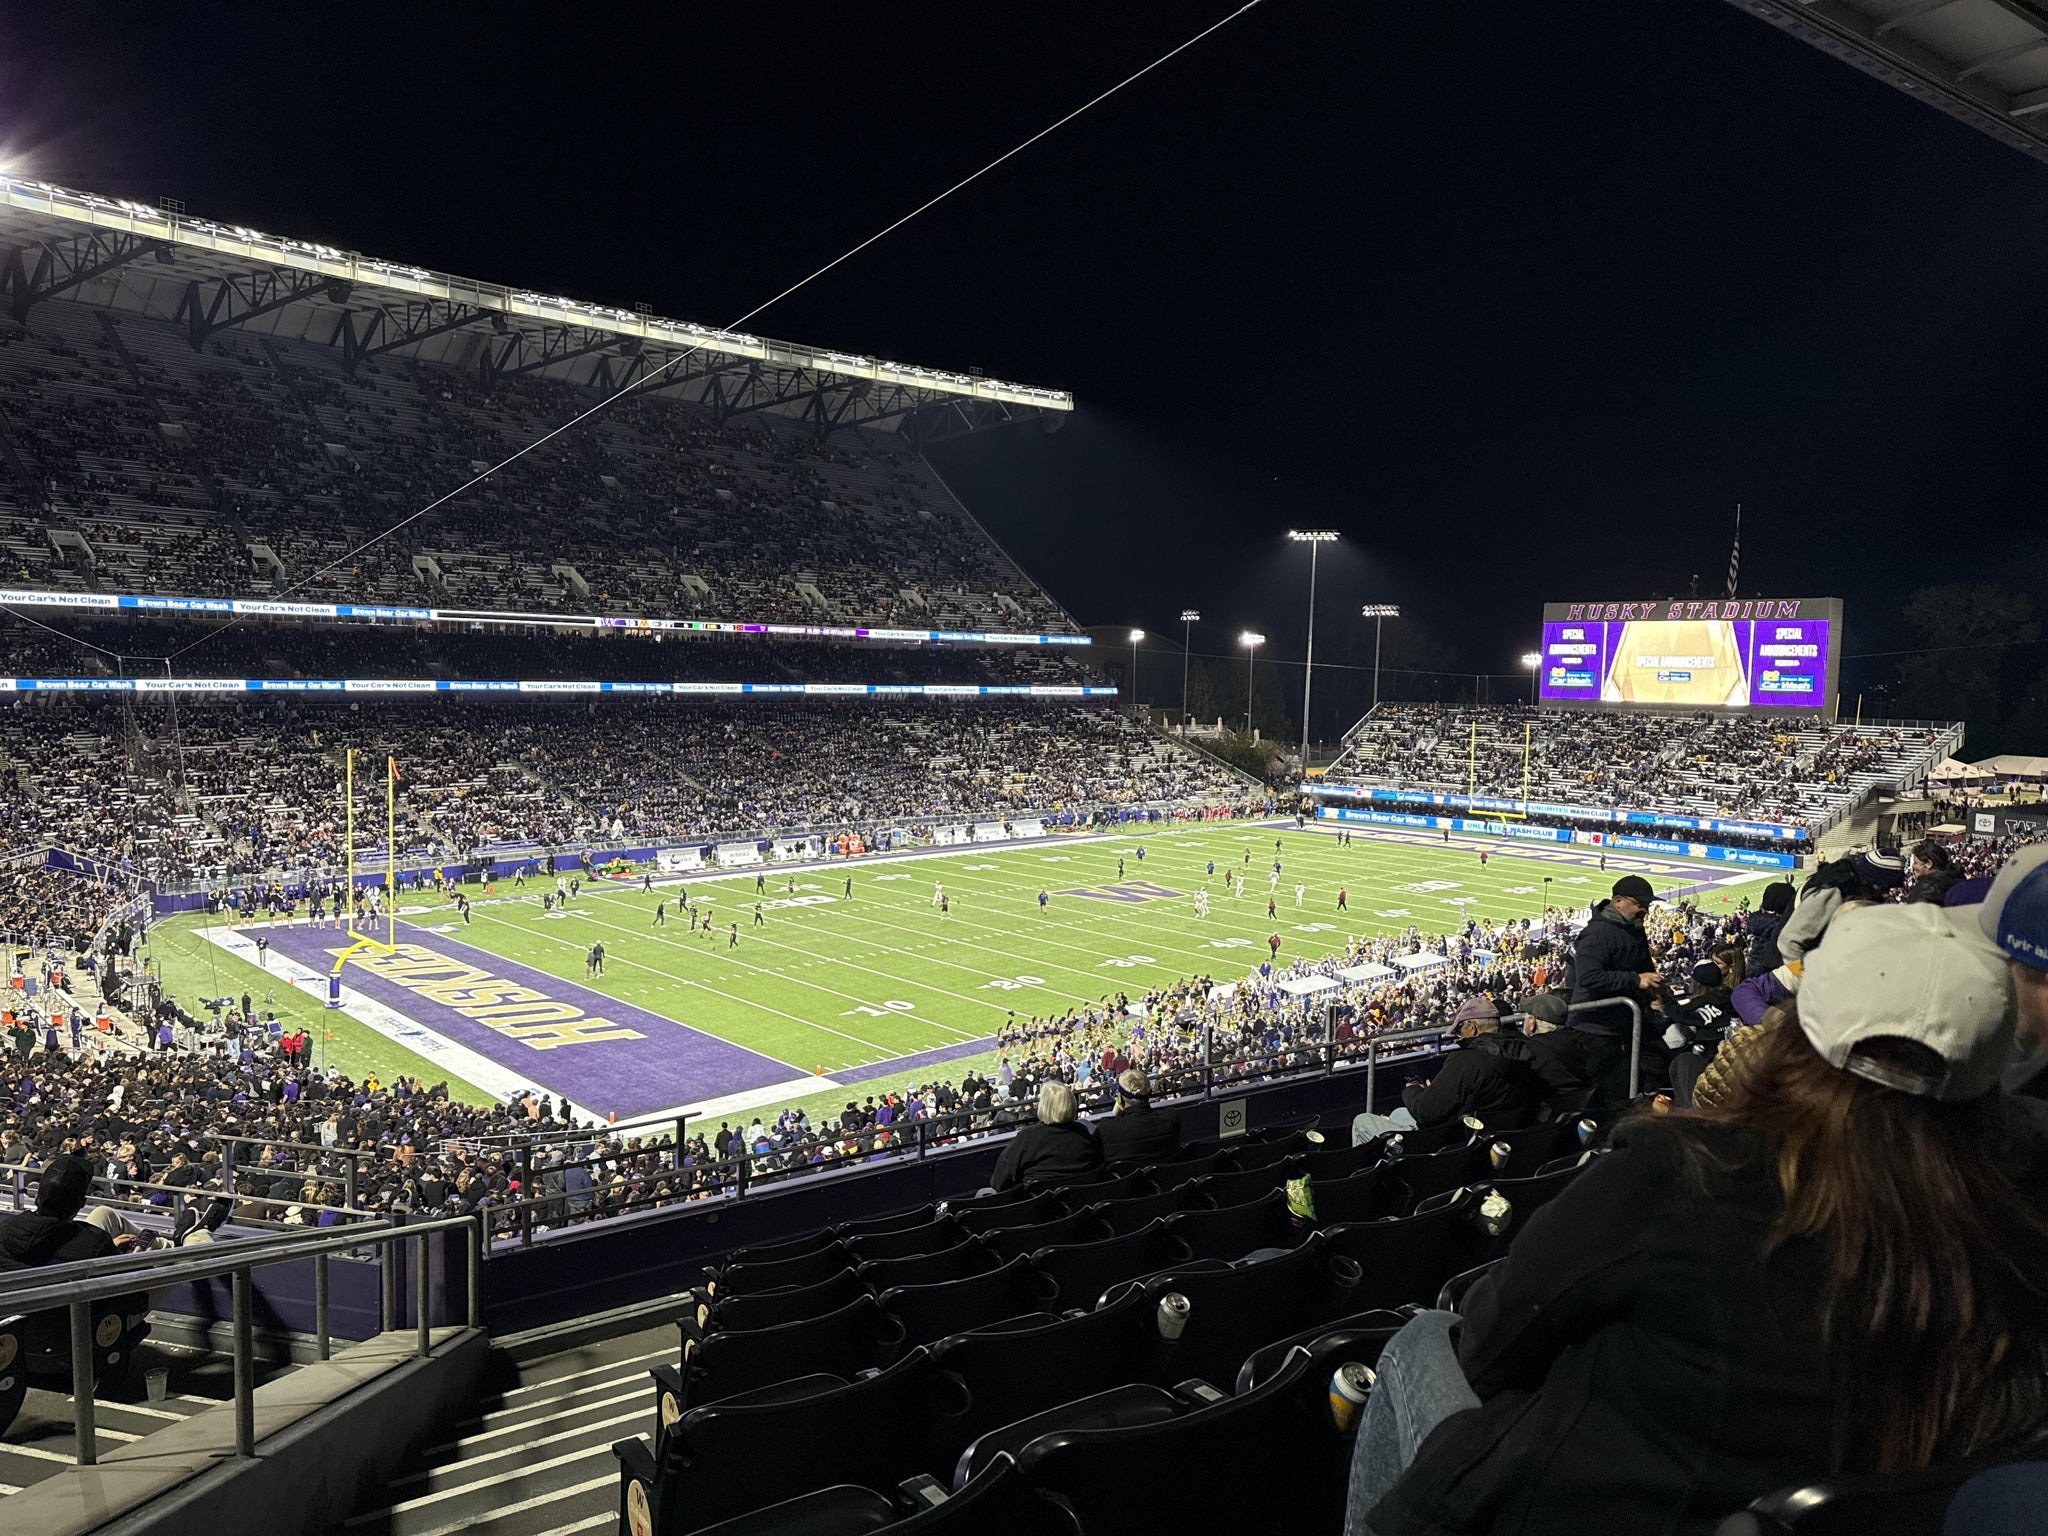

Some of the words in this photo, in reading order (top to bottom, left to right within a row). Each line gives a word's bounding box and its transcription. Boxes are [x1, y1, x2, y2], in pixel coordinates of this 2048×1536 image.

[0, 593, 26, 602] Your
[28, 594, 57, 603] Car's
[59, 596, 78, 604] Not
[80, 597, 111, 605] Clean
[240, 603, 261, 611] Your
[262, 604, 286, 612] Car's
[288, 605, 304, 613] Not
[305, 606, 331, 614] Clean
[1567, 602, 1657, 620] HUSKY
[1668, 600, 1801, 619] STADIUM
[1761, 681, 1781, 689] Car
[1781, 681, 1811, 690] Wash
[1345, 810, 1370, 820] Brown
[1371, 812, 1390, 821] Bear
[1391, 815, 1404, 823] Car
[1405, 815, 1427, 825] Wash
[1530, 805, 1568, 813] UNLIMITED
[1570, 808, 1590, 816] WASH
[1510, 827, 1532, 835] WASH
[1533, 829, 1553, 837] CLUB
[1607, 836, 1680, 852] BownBear.com
[1739, 854, 1780, 865] washgreen
[1048, 880, 1191, 904] W
[989, 975, 1046, 991] 20
[324, 943, 649, 1050] HUSKIES
[855, 1000, 916, 1018] 10
